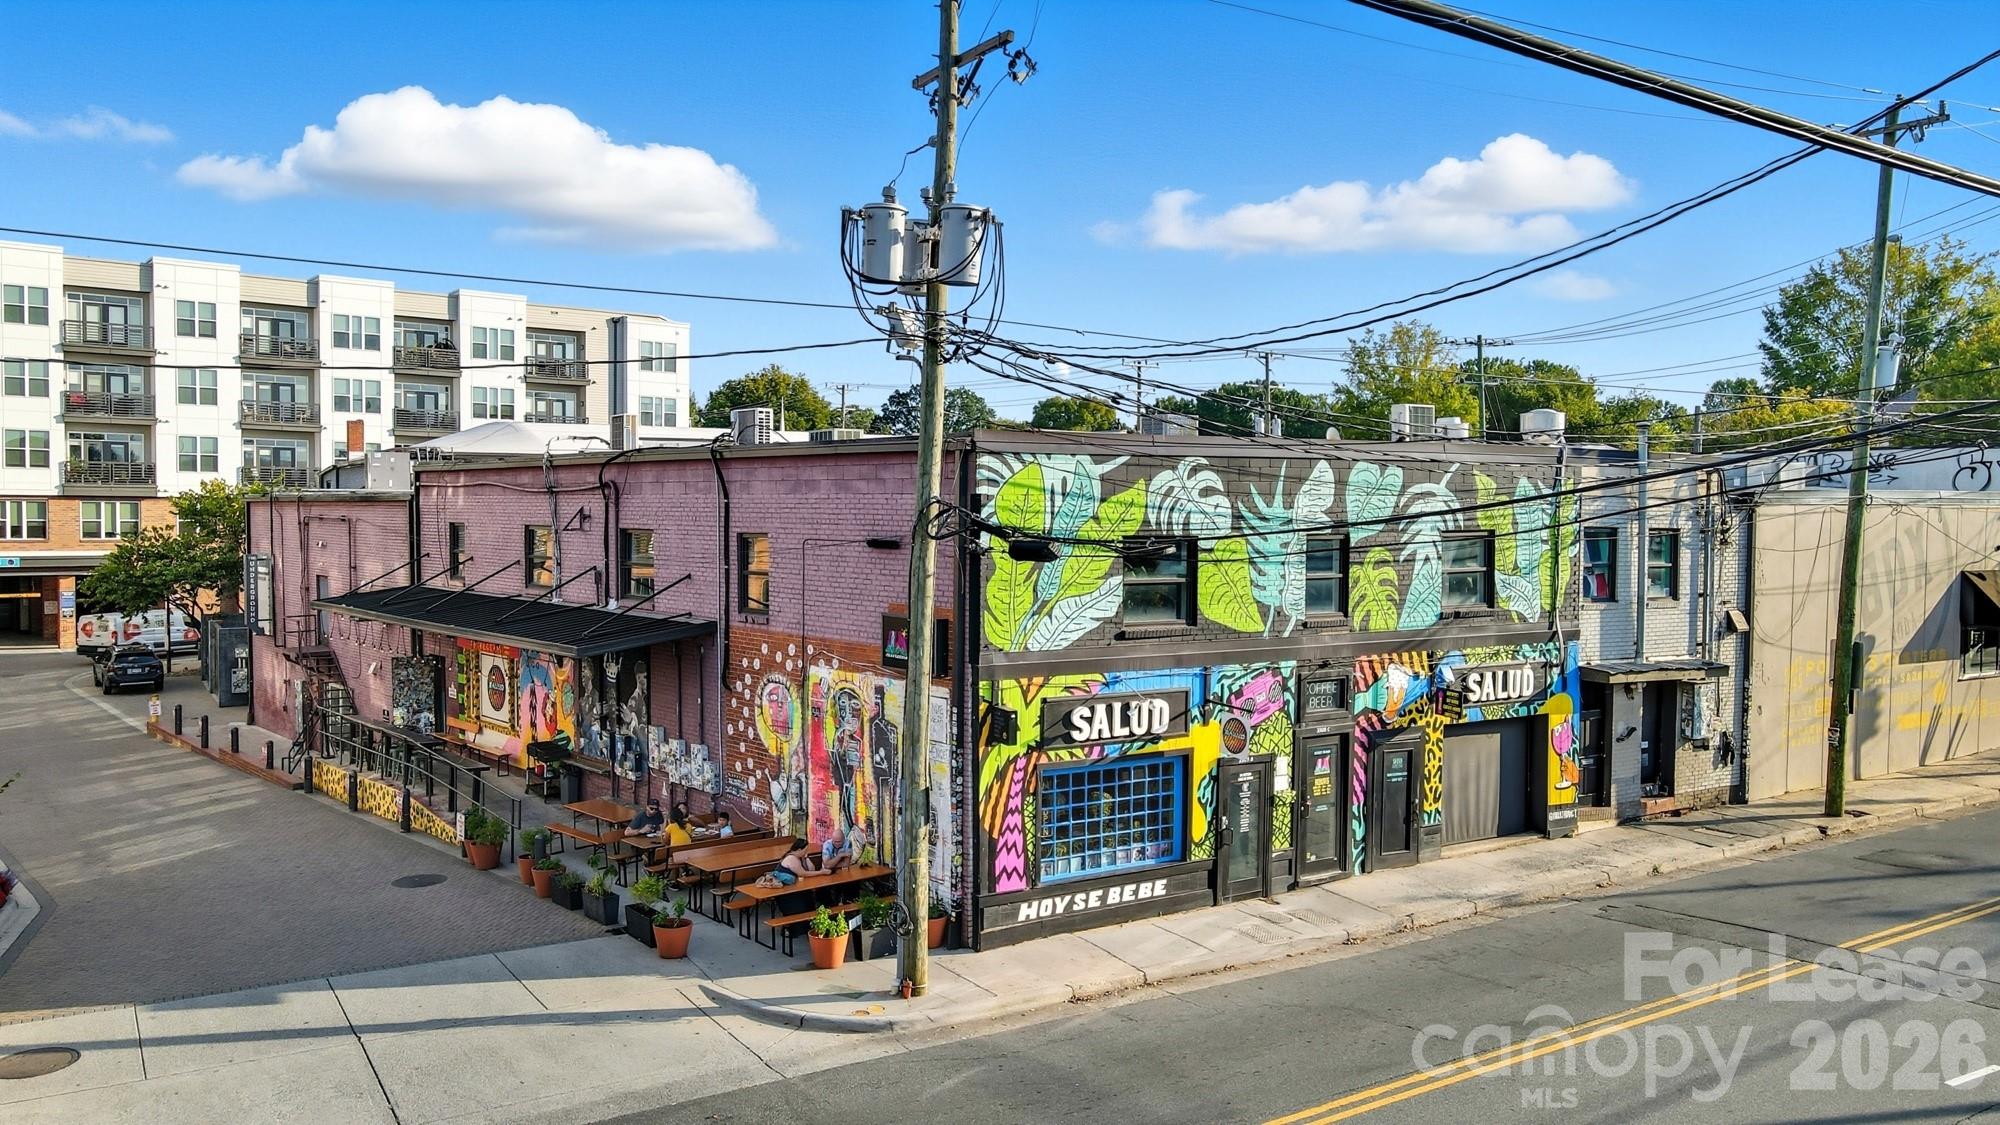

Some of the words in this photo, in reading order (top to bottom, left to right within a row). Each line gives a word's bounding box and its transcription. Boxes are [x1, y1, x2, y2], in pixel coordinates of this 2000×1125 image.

[248, 561, 257, 624] UNDERGROUND
[1309, 696, 1334, 709] BEER
[1467, 668, 1534, 702] SALUD
[1070, 698, 1170, 742] SALUD
[1018, 895, 1069, 922] HOY
[1072, 889, 1103, 911] SE
[1106, 879, 1168, 905] BEBE
